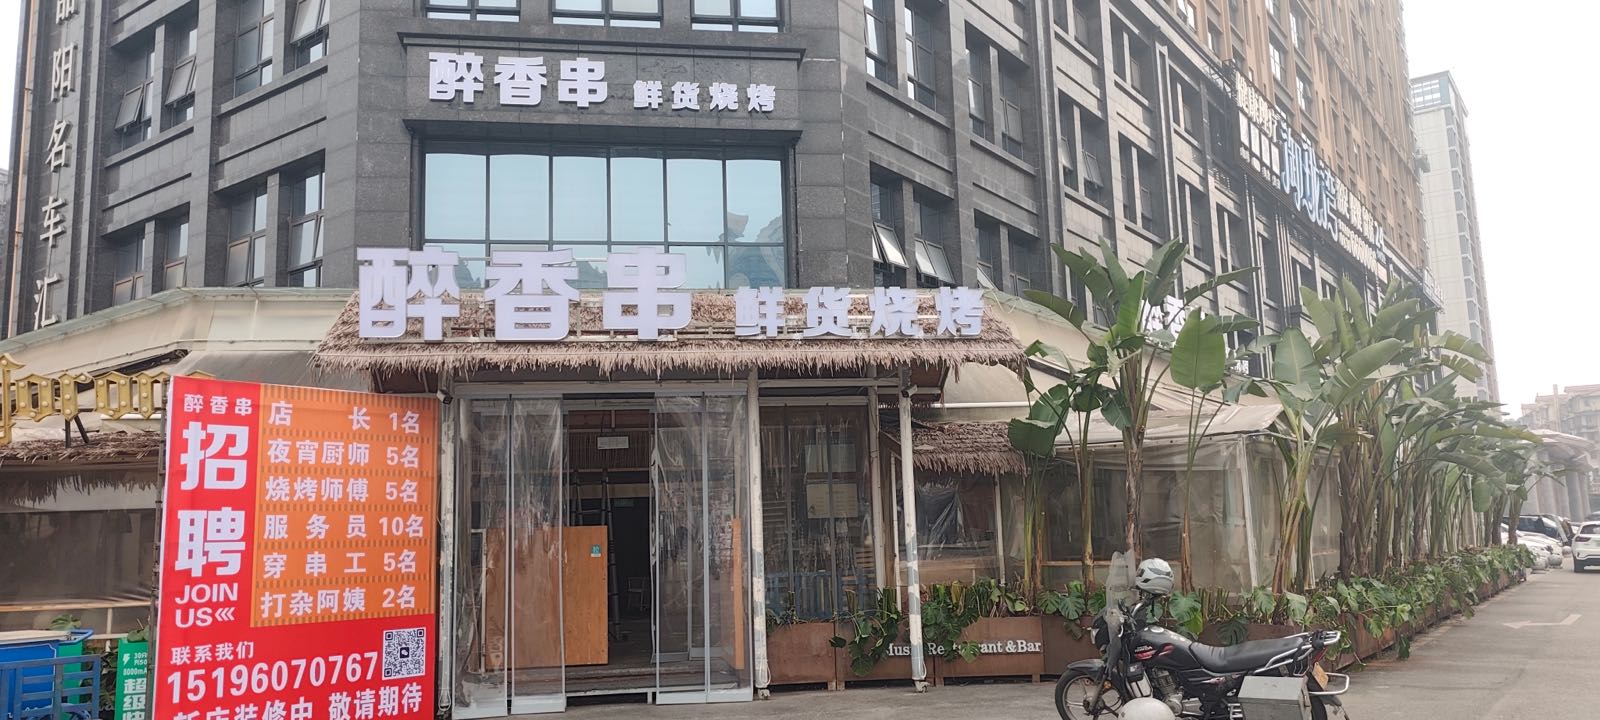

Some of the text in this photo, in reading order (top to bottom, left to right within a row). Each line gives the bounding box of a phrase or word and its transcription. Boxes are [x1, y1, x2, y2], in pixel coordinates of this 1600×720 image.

[428, 51, 776, 112] 醉香串 鲜货烧烤
[357, 245, 984, 342] 醉香串 鲜货烧烤
[183, 393, 253, 416] 醉香串
[388, 411, 420, 434] 1名
[266, 438, 420, 468] 夜宵厨师 5名
[174, 421, 249, 578] 招聘
[264, 475, 419, 504] 烧烤师傅 5名
[263, 513, 424, 541] 服务员 10名
[262, 549, 417, 579] 穿串工 5名
[175, 582, 239, 605] JOIN
[260, 583, 416, 619] 打杂阿姨 2名
[174, 607, 213, 628] US
[170, 640, 254, 666] 联系我们
[167, 651, 378, 704] 15196070767
[328, 682, 422, 720] 敬请期待
